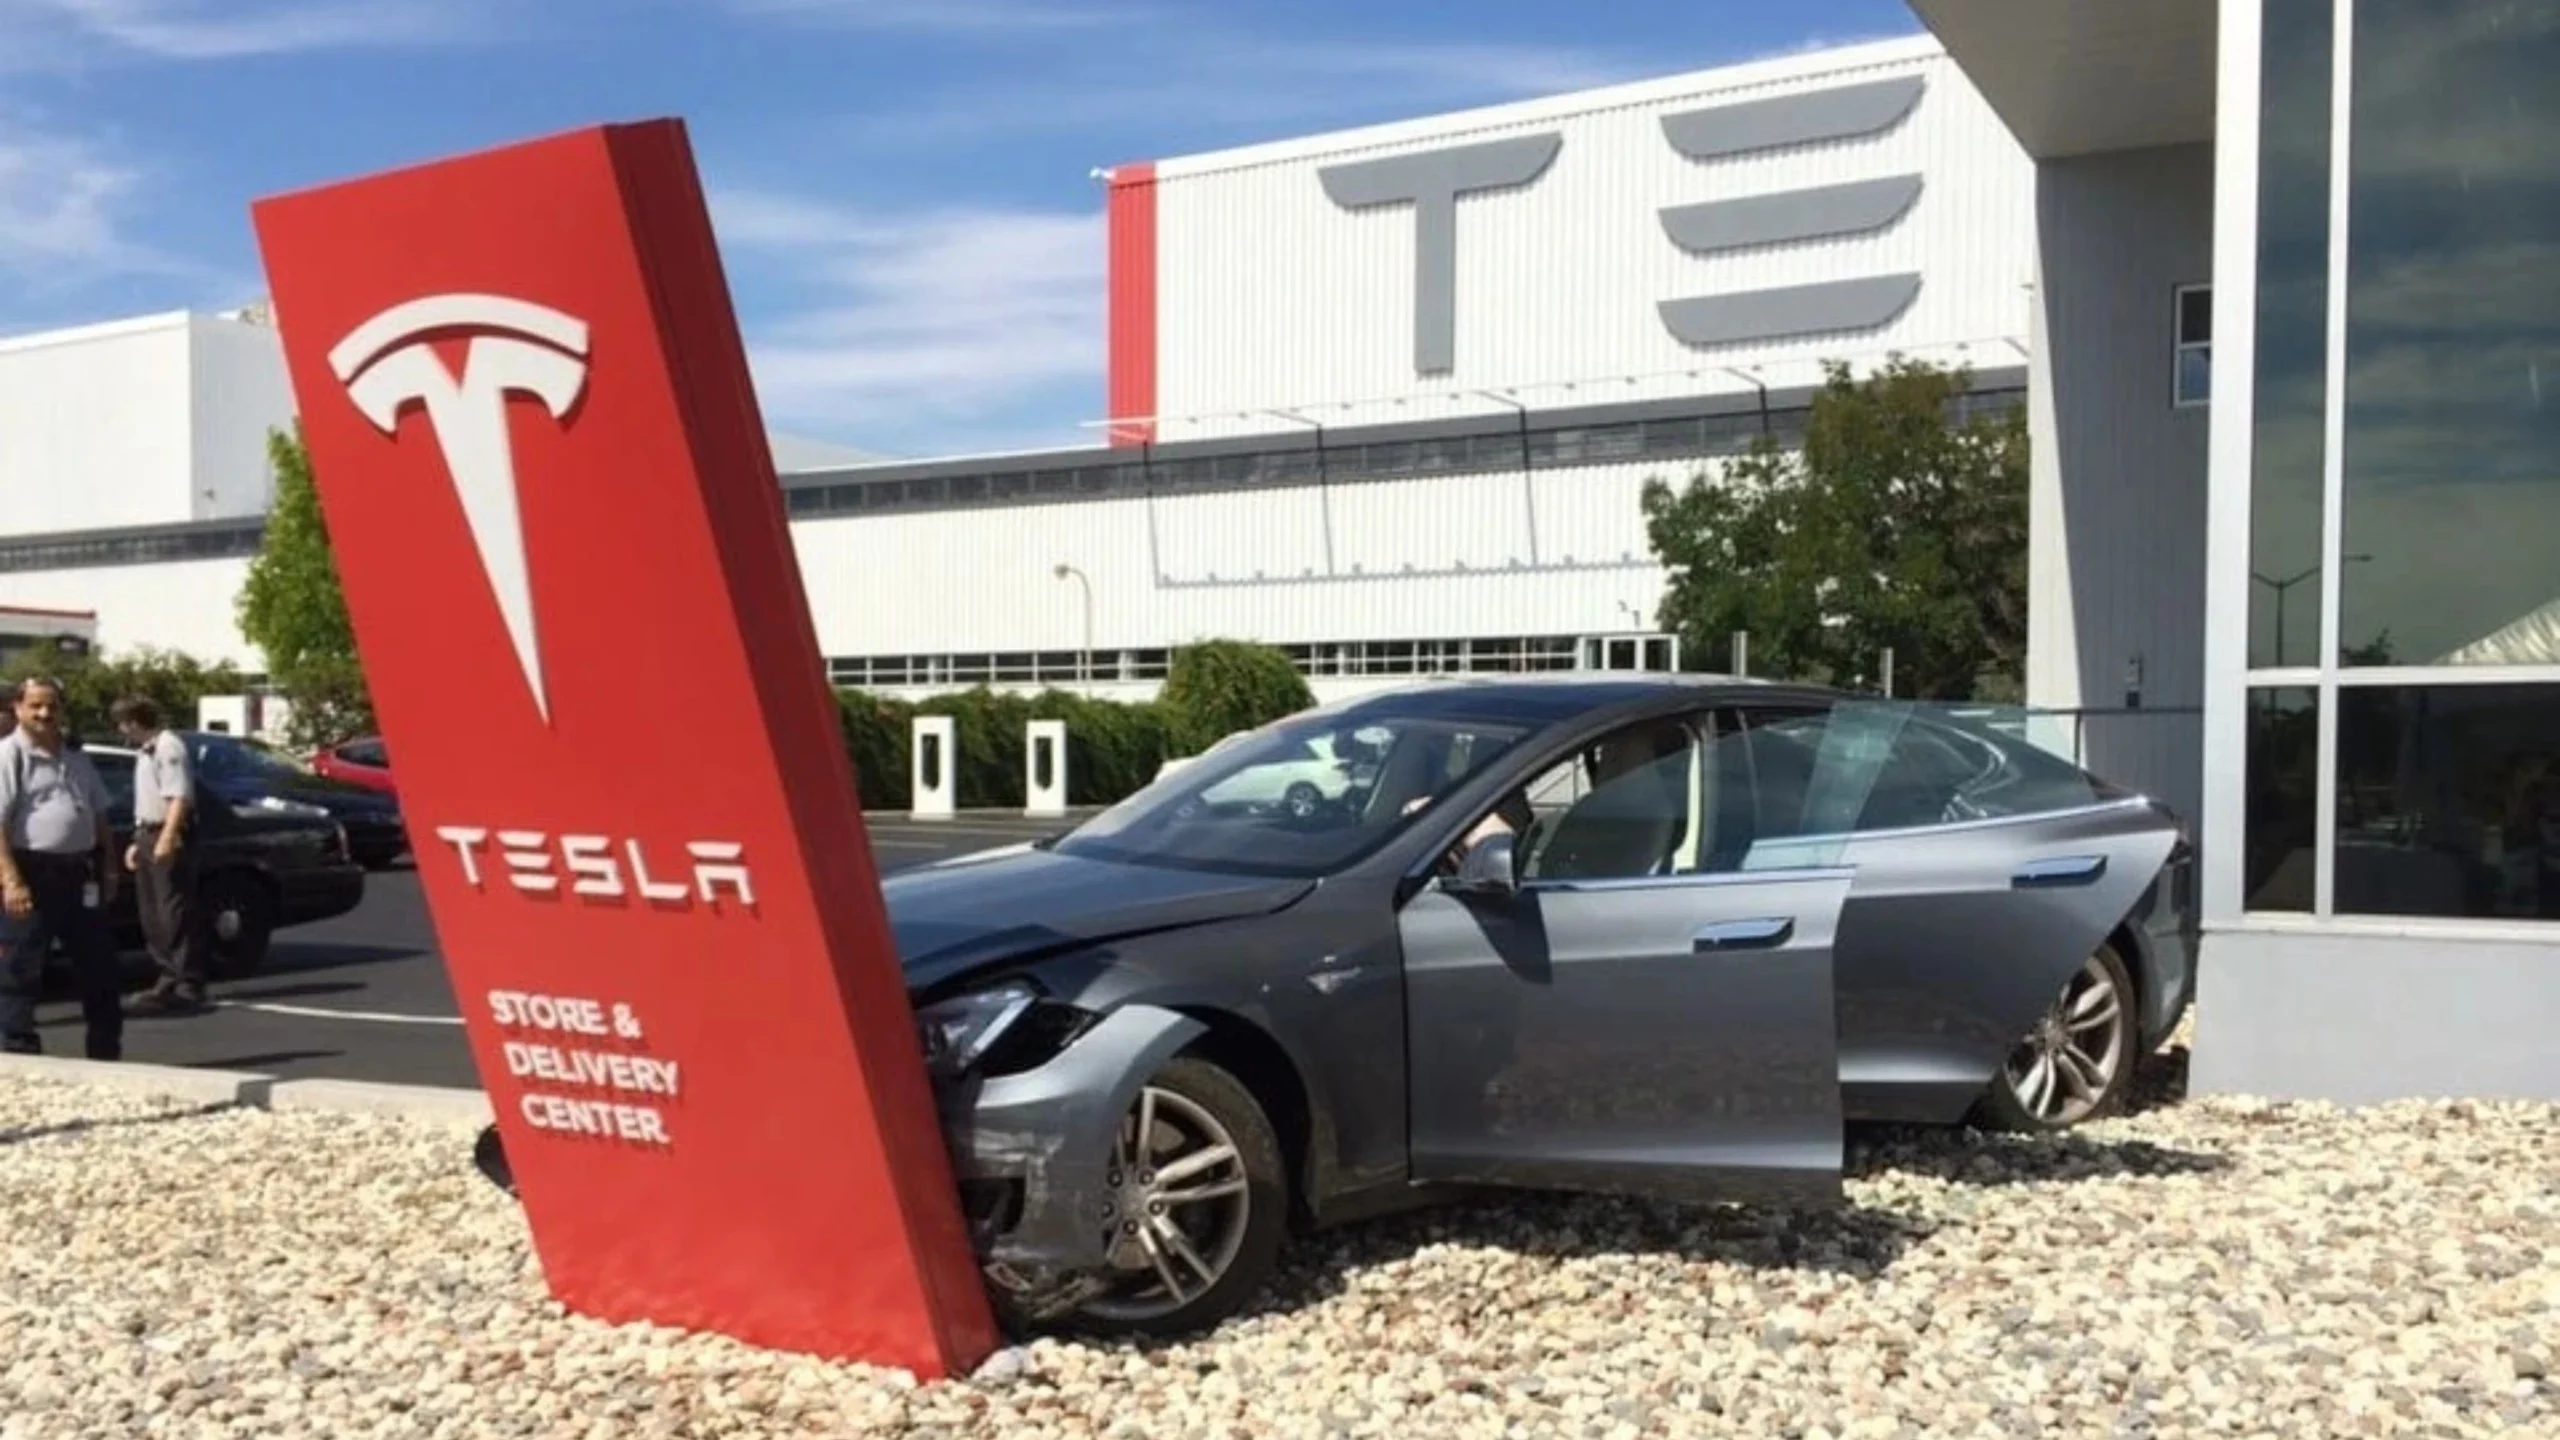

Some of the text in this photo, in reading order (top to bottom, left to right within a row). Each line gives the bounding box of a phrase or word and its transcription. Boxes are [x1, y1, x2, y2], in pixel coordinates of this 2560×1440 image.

[436, 826, 755, 904] TESLA
[487, 989, 642, 1039] STORE &
[502, 1041, 679, 1094] DELIVERY
[520, 1093, 671, 1144] CENTER
